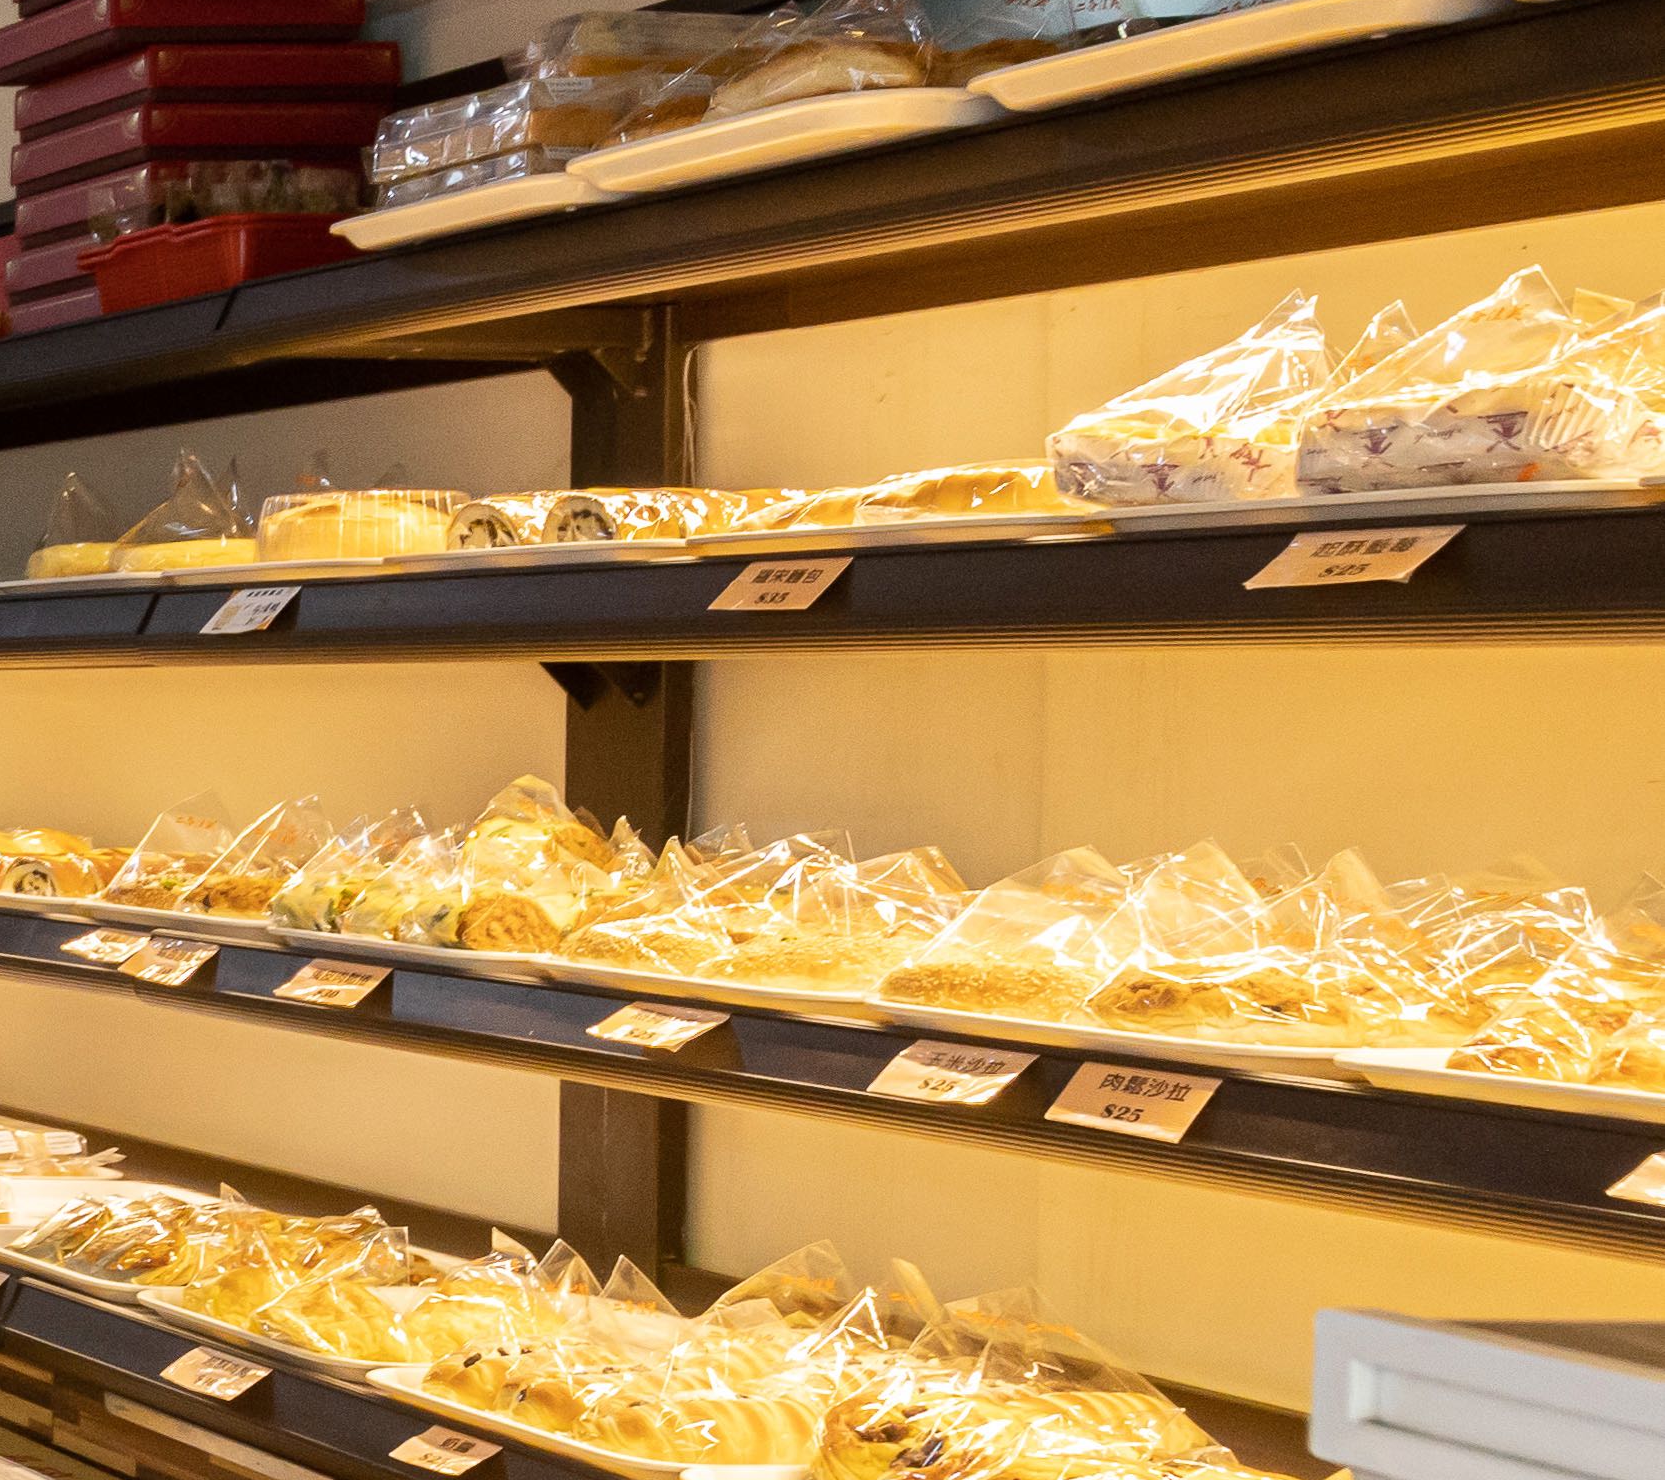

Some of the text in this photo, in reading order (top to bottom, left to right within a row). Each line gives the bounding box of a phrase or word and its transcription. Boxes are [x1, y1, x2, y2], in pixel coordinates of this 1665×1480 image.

[1319, 563, 1371, 577] $25
[917, 1078, 958, 1093] $25
[1099, 1073, 1193, 1103] 肉鬆沙拉
[1102, 1104, 1145, 1123] $25
